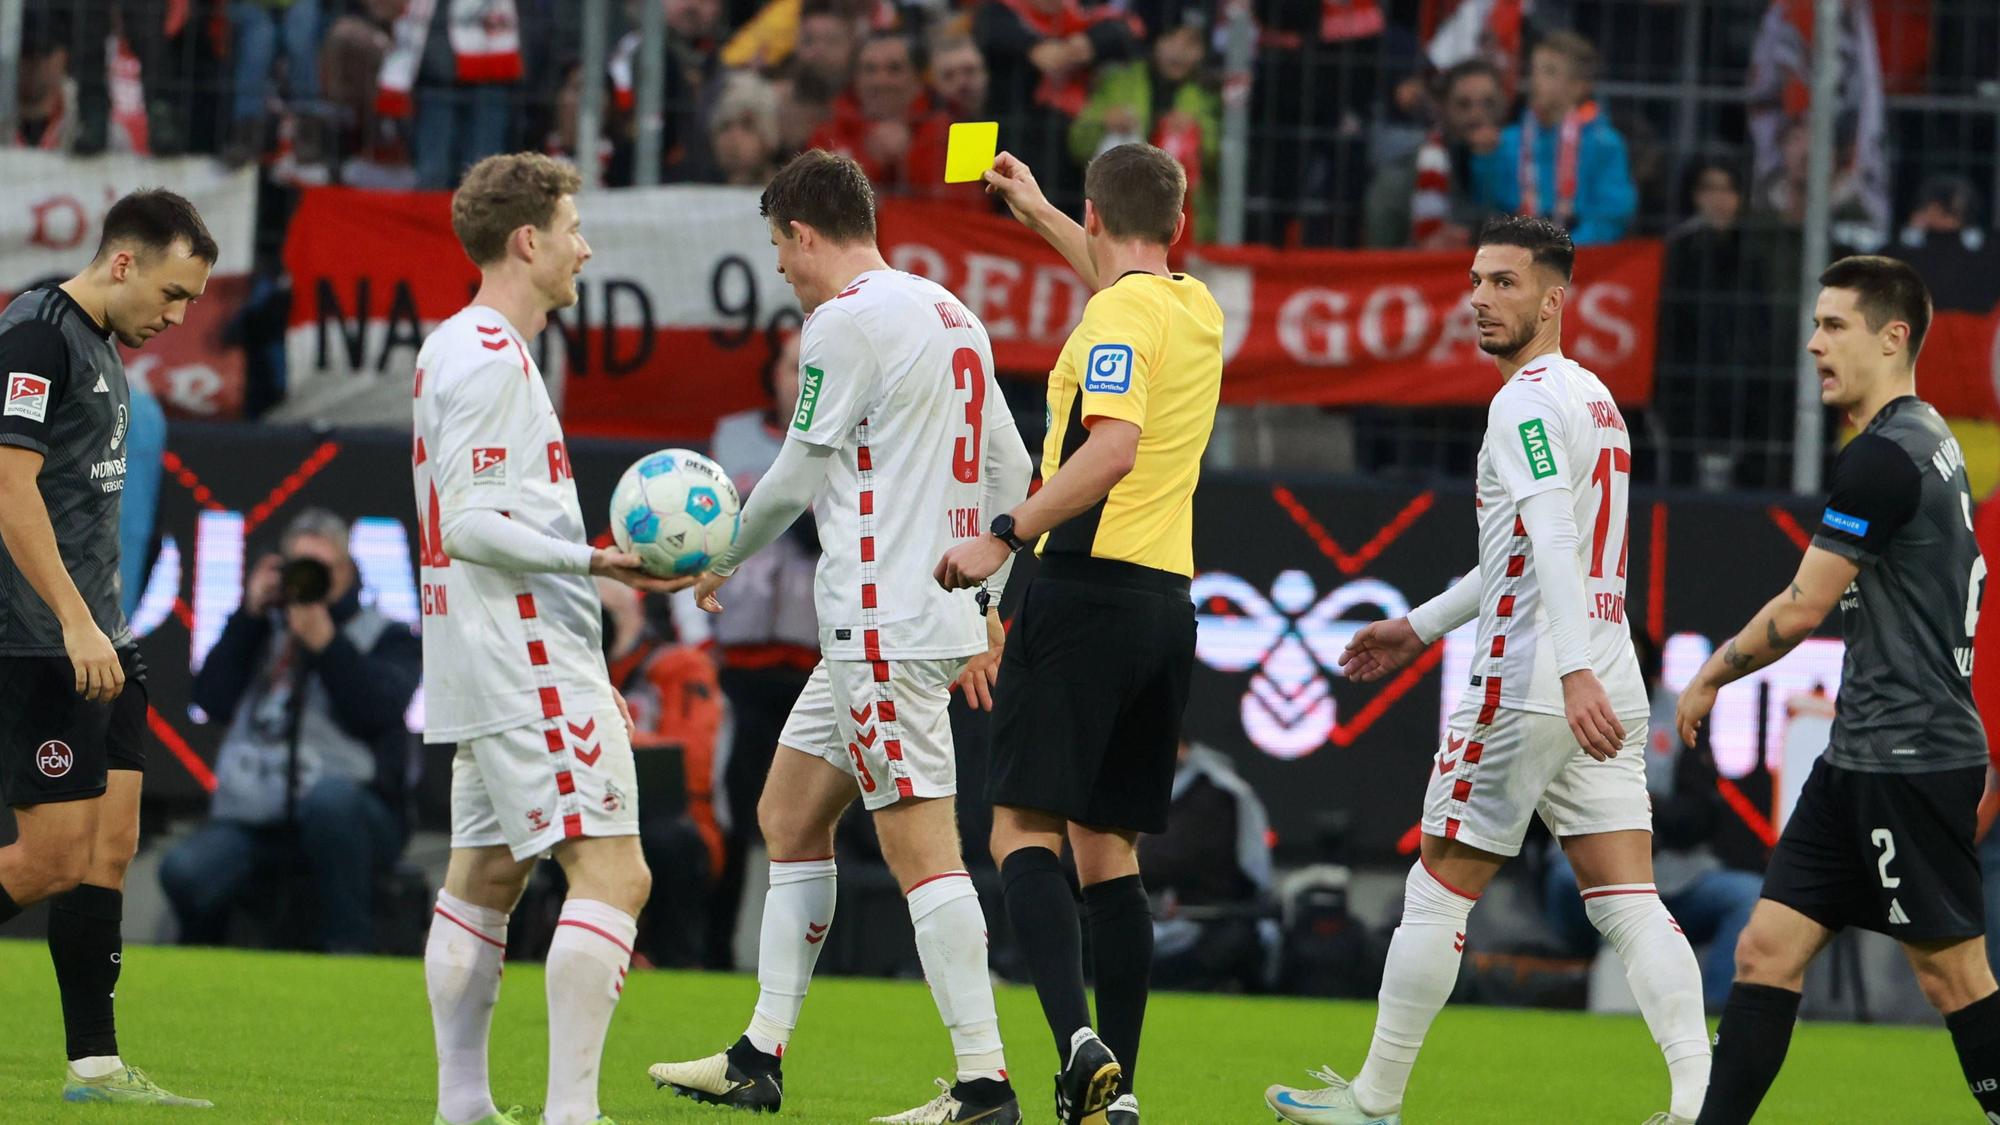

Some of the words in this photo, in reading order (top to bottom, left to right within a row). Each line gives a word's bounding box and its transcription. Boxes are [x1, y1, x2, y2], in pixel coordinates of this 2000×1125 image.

[1277, 284, 1638, 372] GOAS
[796, 373, 819, 426] DEVK
[952, 347, 986, 484] 3
[1525, 424, 1552, 475] DEVK
[1589, 447, 1630, 578] 17
[40, 754, 70, 770] FCN
[848, 742, 877, 793] 3
[1871, 828, 1901, 889] 2
